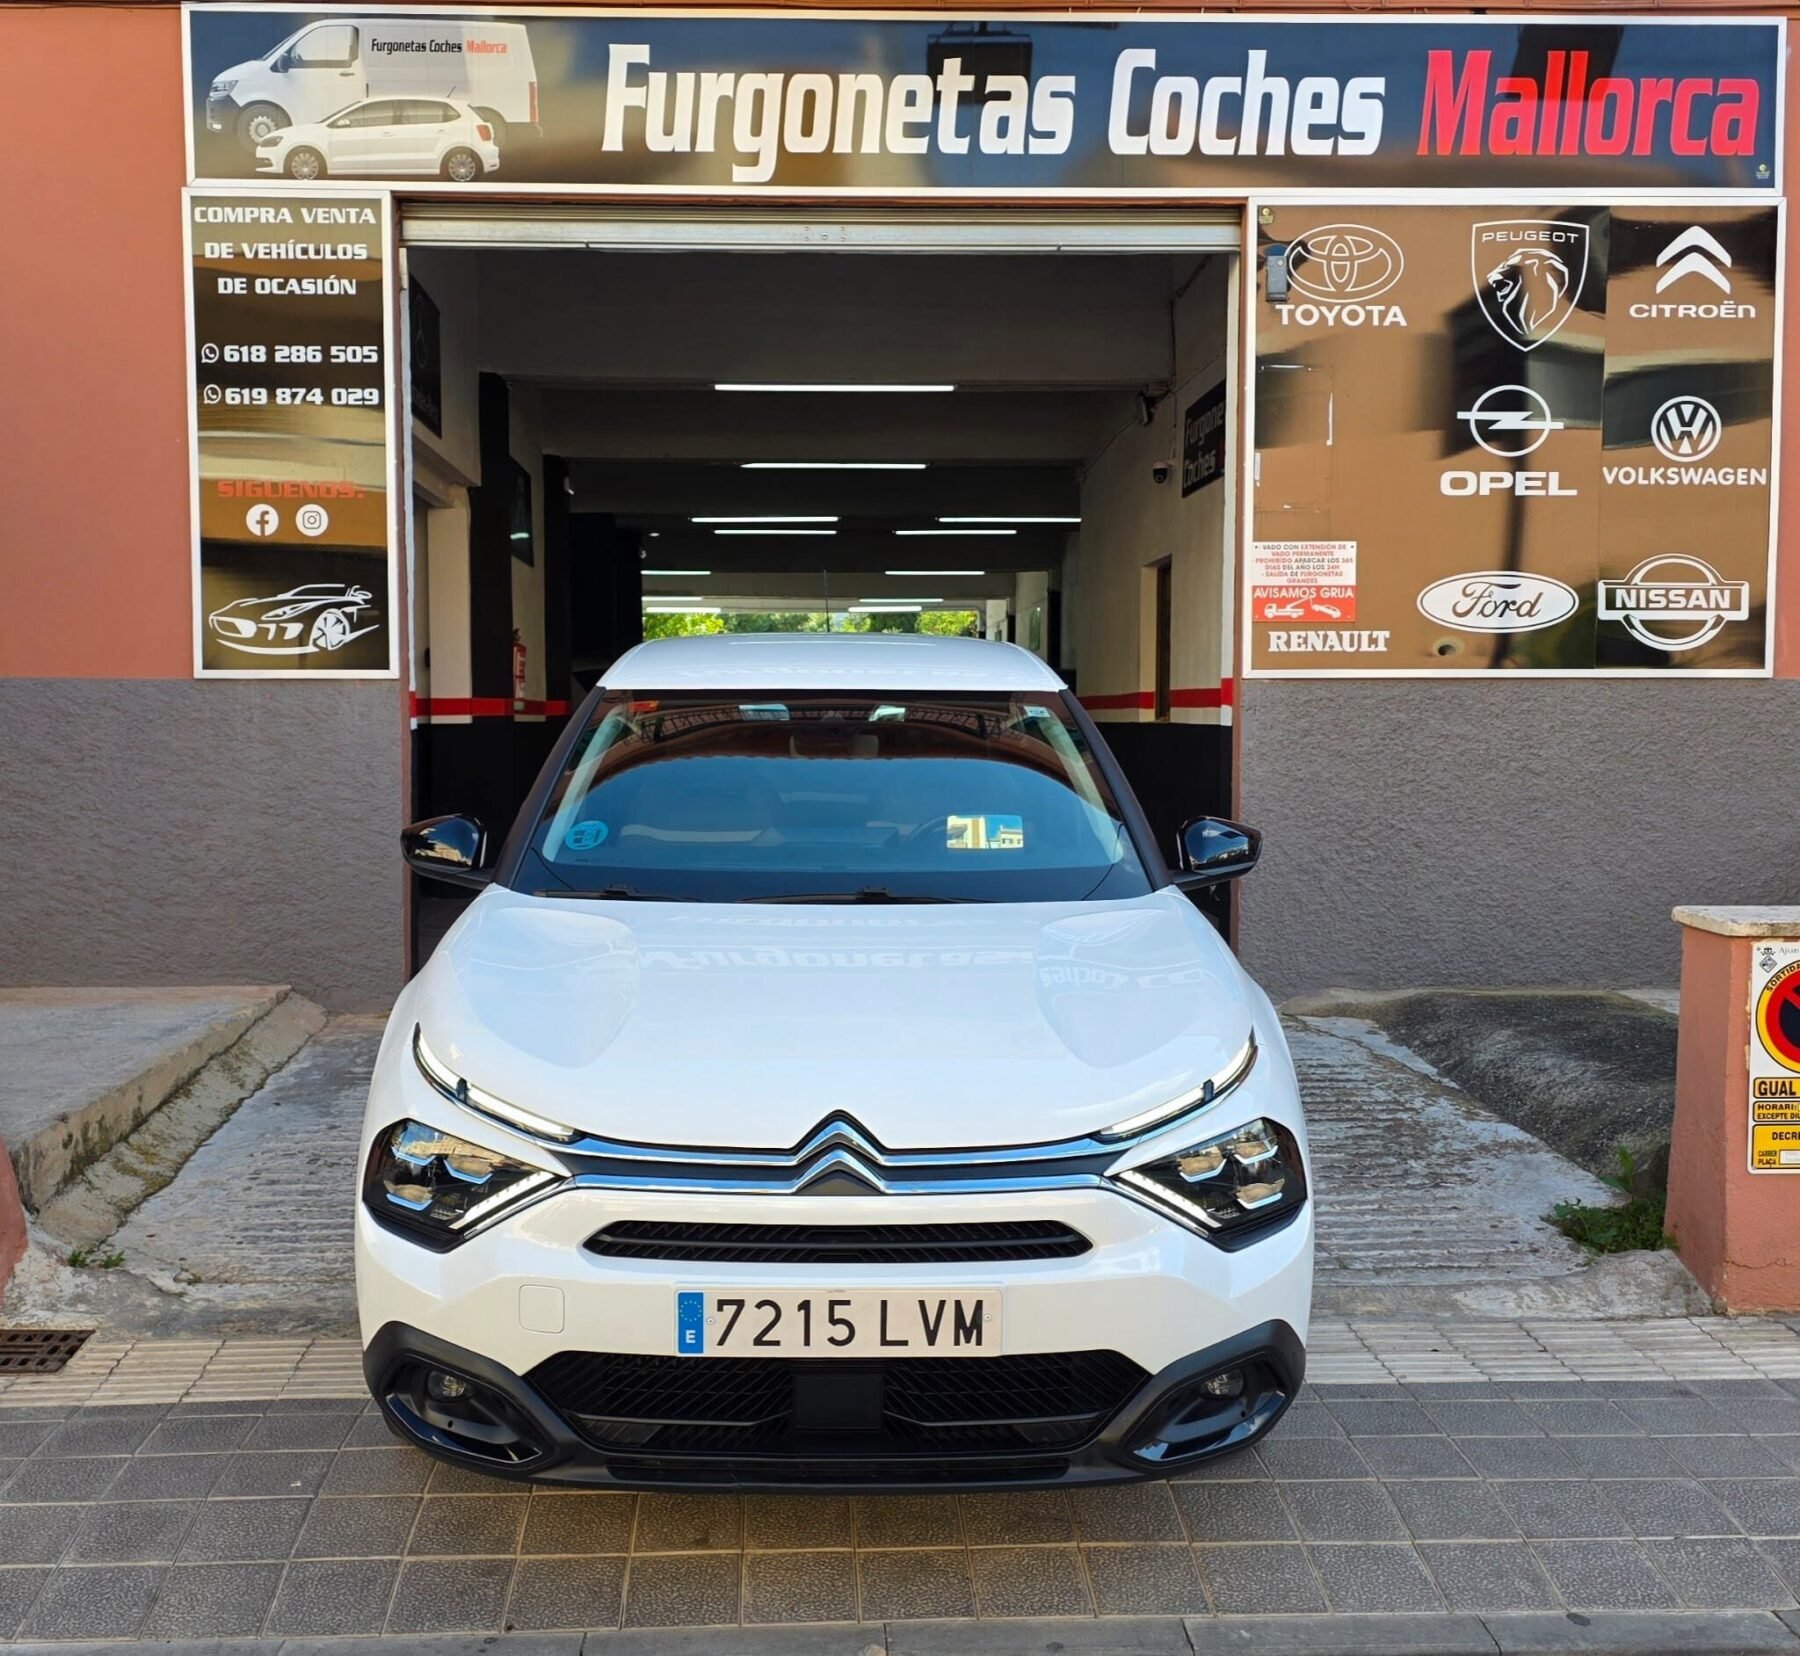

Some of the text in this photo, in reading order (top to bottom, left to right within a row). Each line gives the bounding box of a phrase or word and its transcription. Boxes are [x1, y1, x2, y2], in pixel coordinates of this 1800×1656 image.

[371, 38, 507, 55] Furgonetas Coches Mallorca
[602, 43, 1760, 182] Furgonetas Coches Mallorca
[194, 206, 376, 224] COMPRA VENTA
[1481, 230, 1579, 244] PEUGEOT
[204, 239, 368, 260] DE VEHÍCULOS
[217, 275, 357, 295] DE OCASIÓN
[1275, 304, 1407, 327] TOYOTA
[223, 345, 378, 363] 618 286 505
[224, 387, 379, 405] 619 874 029
[1440, 470, 1577, 496] OPEL
[1602, 466, 1767, 486] VOLKSWAGEN
[1253, 587, 1355, 599] AVISAMOS GRUA
[1452, 581, 1544, 618] Ford
[1615, 588, 1730, 609] NISSAN
[1268, 630, 1390, 652] RENAULT
[1757, 1080, 1796, 1097] GUAL
[1757, 1112, 1788, 1120] EXCEPTE
[685, 1298, 983, 1347] E 7215 LVM
